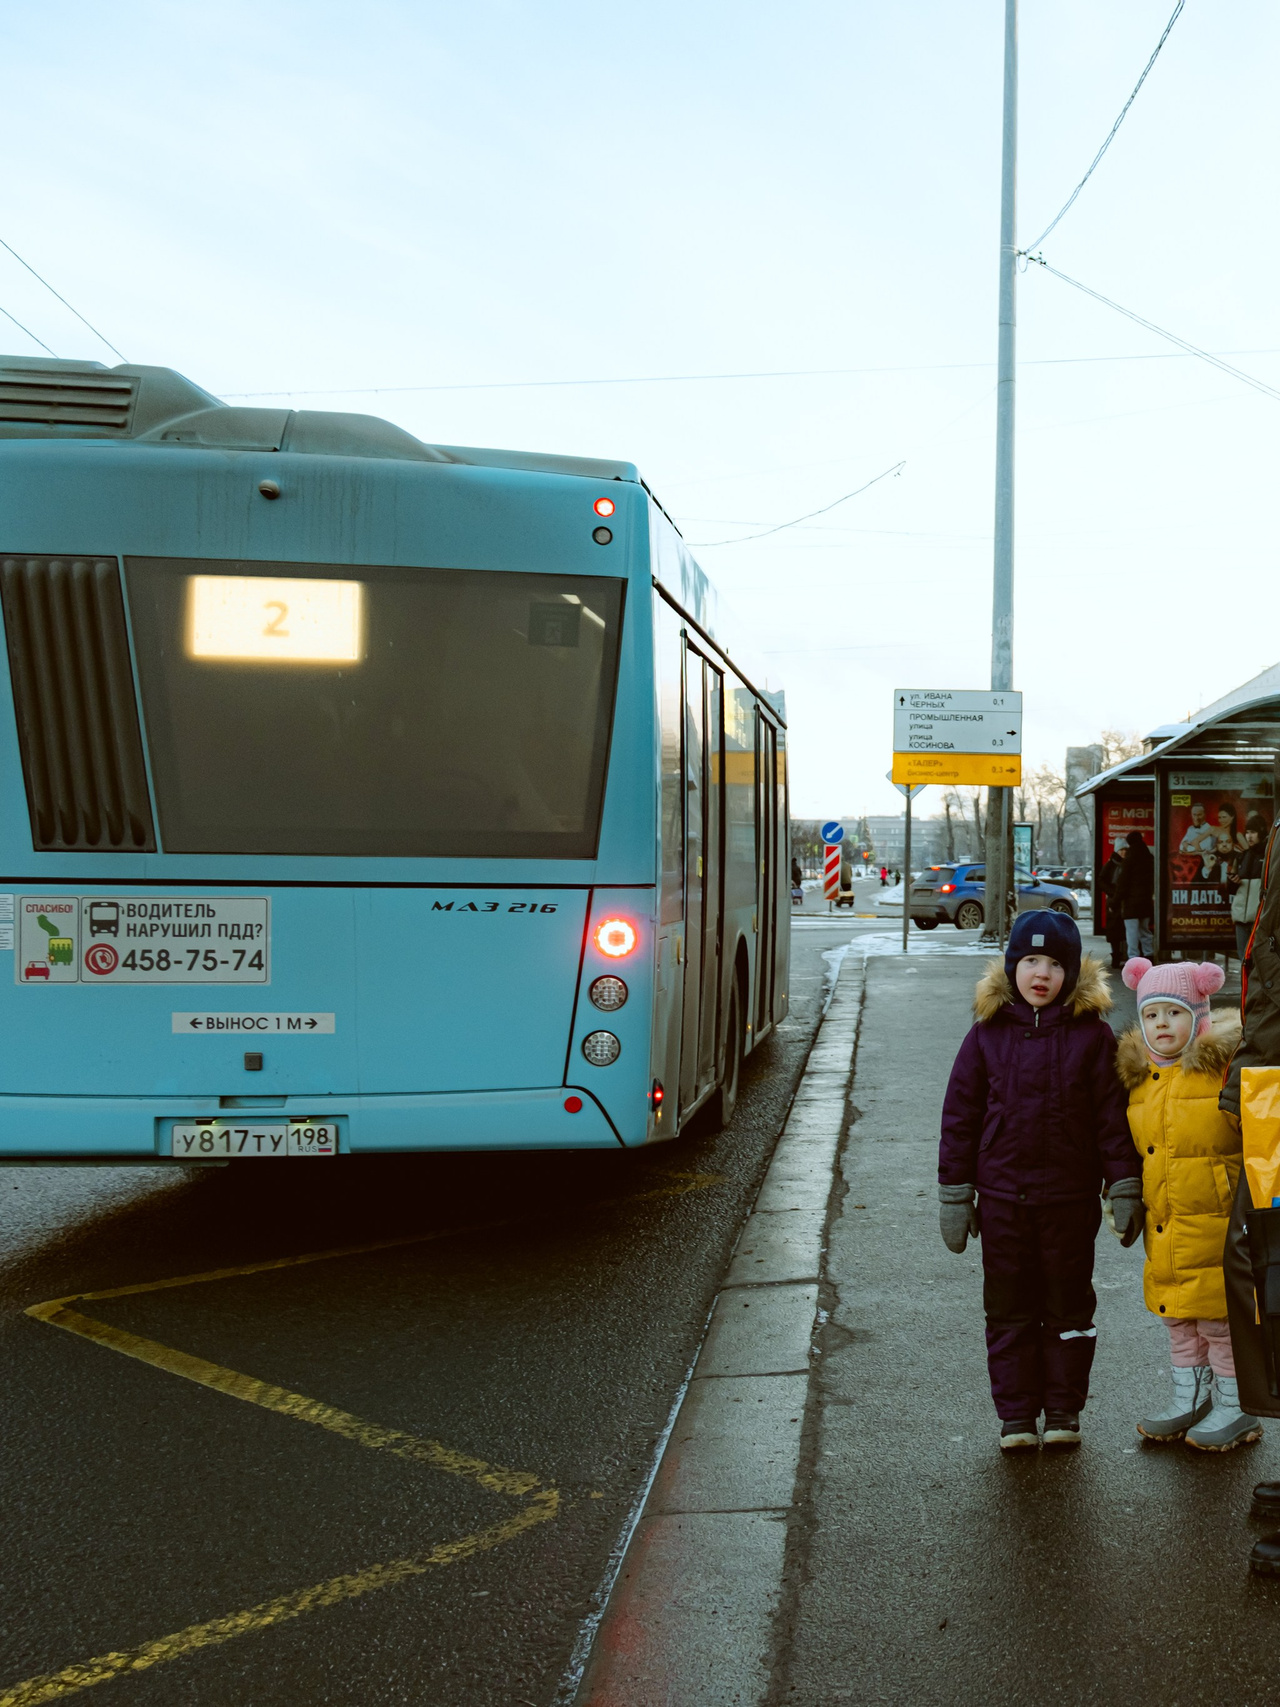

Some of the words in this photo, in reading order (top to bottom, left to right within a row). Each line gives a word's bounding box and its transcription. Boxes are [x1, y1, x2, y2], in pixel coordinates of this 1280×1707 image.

[261, 600, 290, 638] 2
[910, 693, 921, 701] ул.
[910, 701, 945, 709] ЧЕРНЫХ
[909, 713, 984, 722] ПРОМЫШЛЕННАЯ
[909, 723, 933, 731] улица
[908, 742, 955, 750] КОСИНОВА
[1173, 776, 1186, 786] 31
[1172, 889, 1188, 905] НИ
[25, 903, 74, 914] СПАСИБО!
[126, 903, 216, 920] ВОДИТЕЛЬ
[431, 901, 500, 912] МАЗ
[508, 902, 559, 914] 216
[1172, 917, 1208, 926] РОМАН
[1210, 917, 1235, 926] ПОС
[126, 923, 212, 938] НАРУШИЛ
[217, 923, 263, 940] ПДД?
[121, 949, 264, 972] 458-75-74
[206, 1017, 268, 1030] ВЫНОС
[275, 1017, 281, 1030] 1
[297, 1145, 318, 1153] RUS
